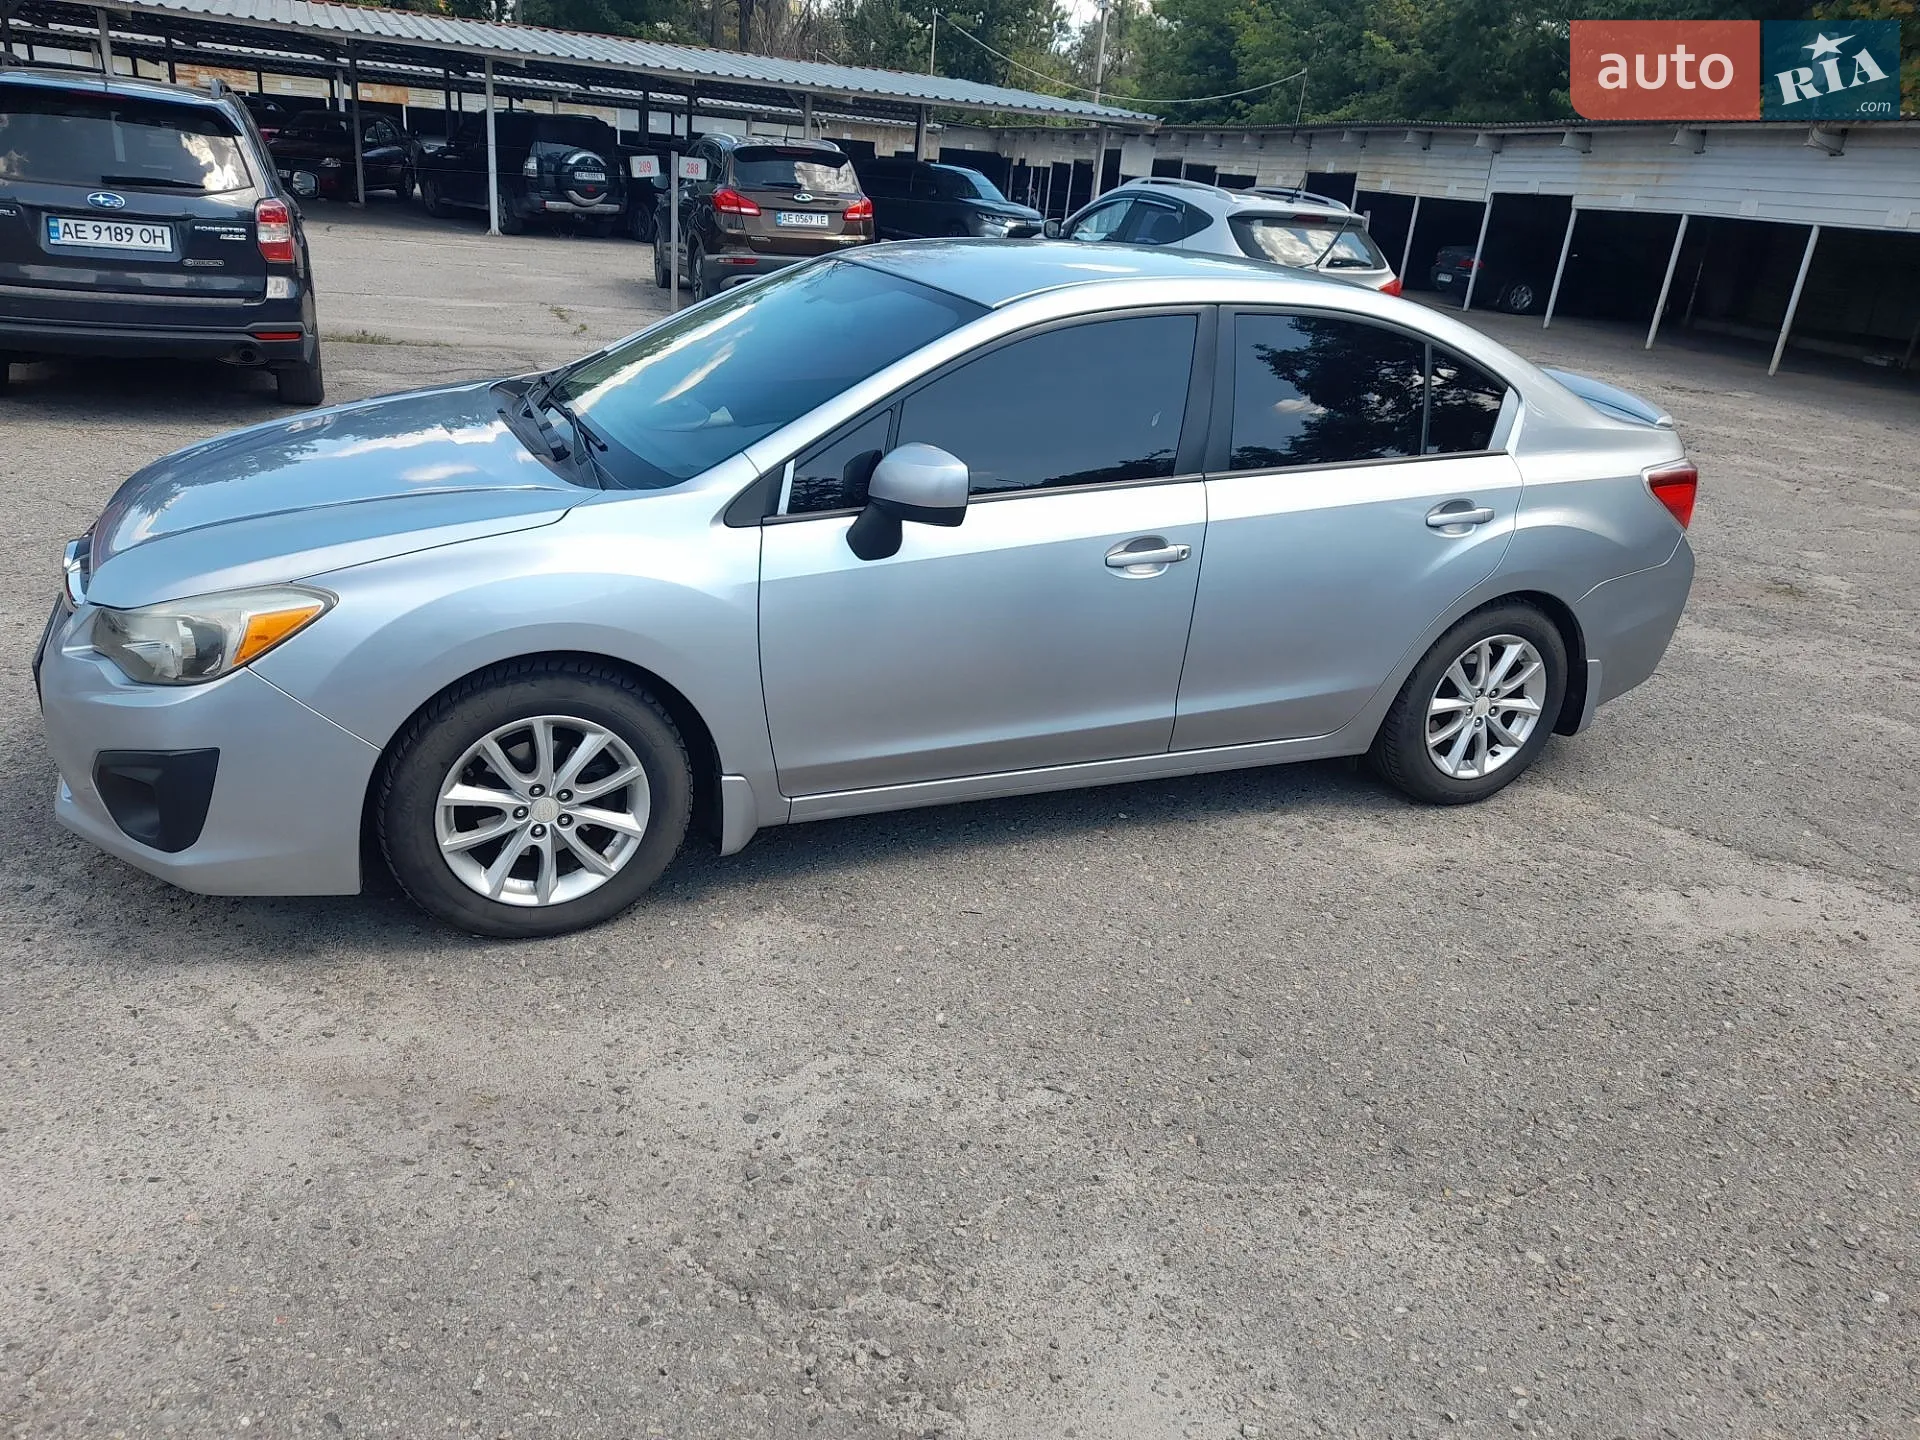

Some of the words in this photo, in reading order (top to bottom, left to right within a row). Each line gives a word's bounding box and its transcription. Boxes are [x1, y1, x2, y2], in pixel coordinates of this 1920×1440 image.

[783, 213, 793, 223] AE
[795, 214, 813, 224] 0569
[61, 222, 88, 240] AE
[92, 224, 134, 243] 9189
[139, 228, 165, 245] OH
